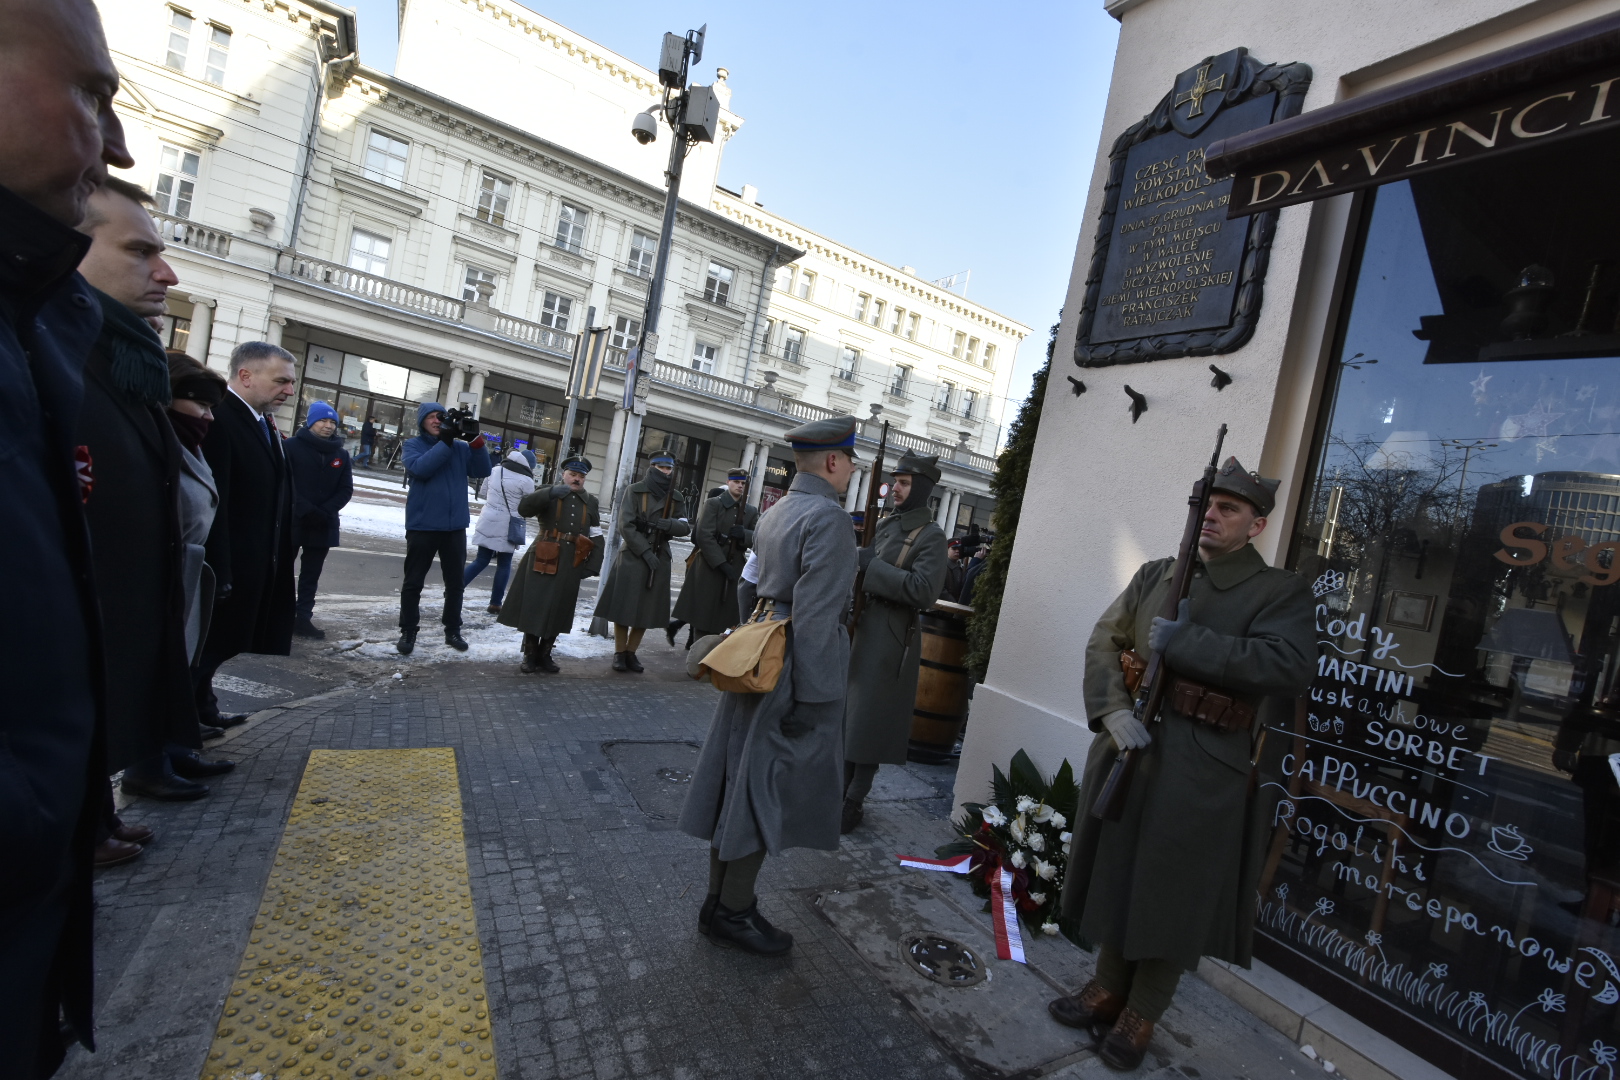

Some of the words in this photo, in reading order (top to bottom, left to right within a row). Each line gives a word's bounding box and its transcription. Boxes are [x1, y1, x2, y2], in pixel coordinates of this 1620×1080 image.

[1120, 219, 1145, 234] DNIA
[1163, 200, 1214, 221] GRUDNIA
[1129, 244, 1138, 254] W
[1142, 237, 1165, 250] TYM
[1171, 221, 1222, 243] MIEJSCU
[1143, 252, 1152, 261] W
[1158, 240, 1198, 257] WALCE
[1121, 269, 1179, 290] OJCZYZNY
[1185, 262, 1212, 277] SYN
[1125, 268, 1132, 278] O
[1135, 249, 1214, 275] WYZWOLENIE
[1101, 292, 1130, 306] ZIEMI
[1136, 271, 1233, 299] WIELKOPOLSKIEJ
[1121, 291, 1201, 314] FRANCISZEK
[1123, 305, 1195, 327] RATAJCZAK
[1364, 721, 1499, 776] SORBET
[1280, 753, 1471, 839] CAPPUCCINO
[1332, 861, 1596, 988] marcepanowe
